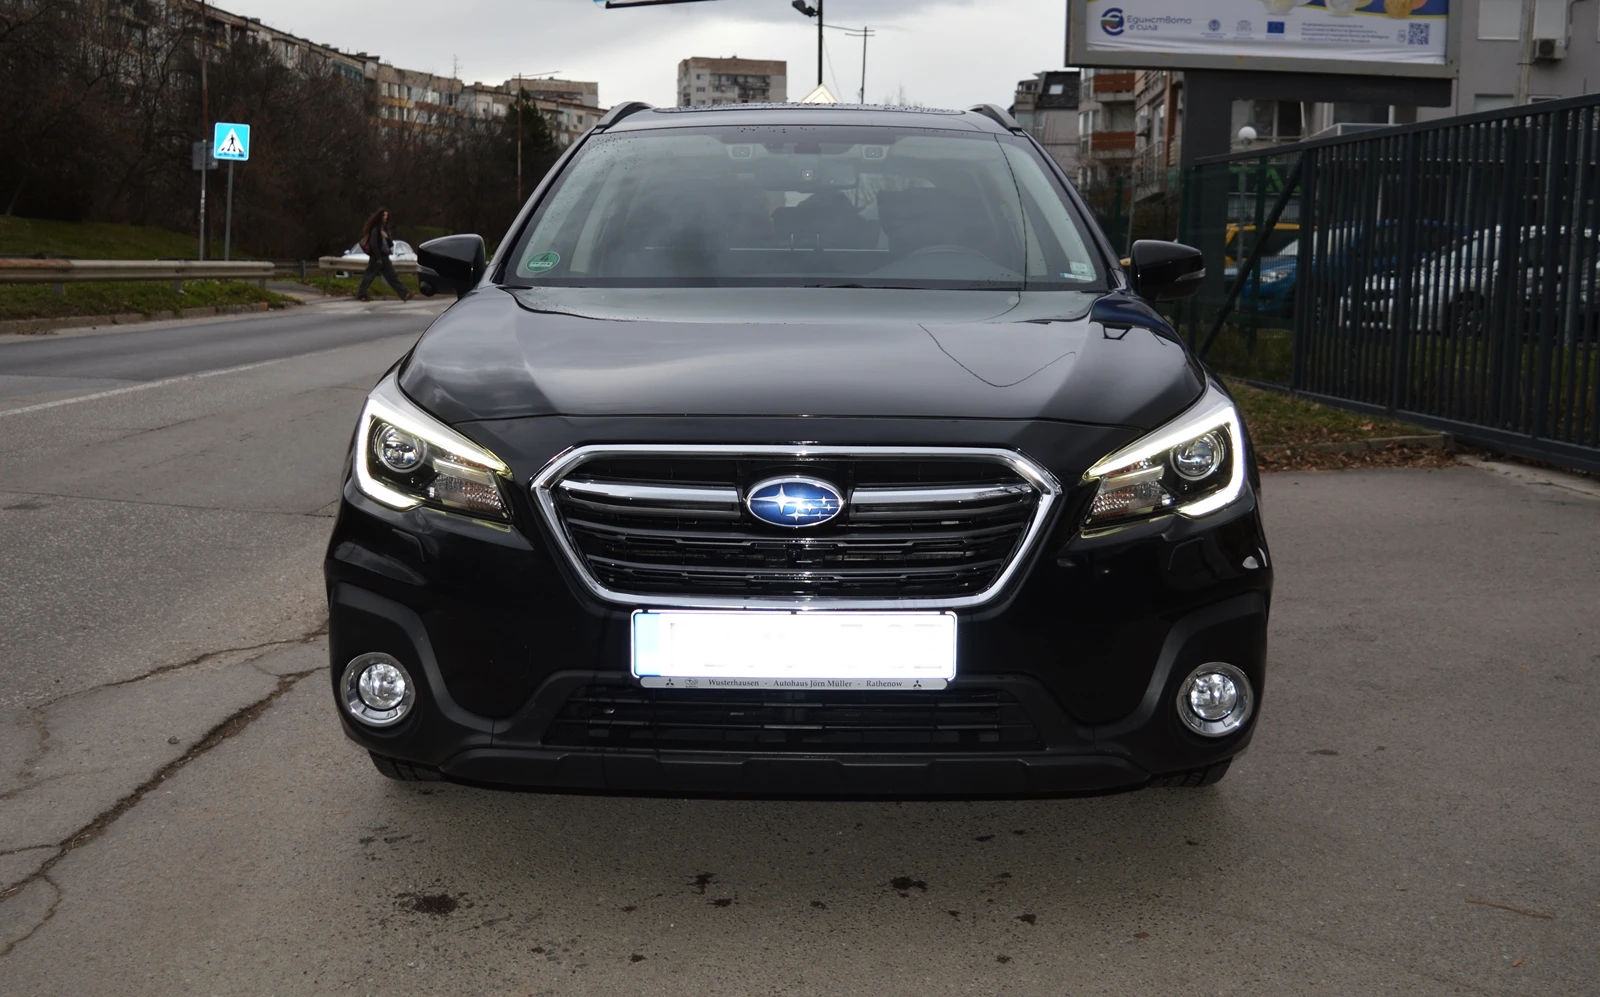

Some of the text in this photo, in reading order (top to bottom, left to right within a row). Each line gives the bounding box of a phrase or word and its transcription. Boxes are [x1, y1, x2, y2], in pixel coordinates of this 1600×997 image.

[1127, 15, 1192, 25] Единството
[708, 679, 759, 687] Wusterhausen
[773, 679, 808, 687] Autohaus
[810, 679, 825, 688] Jörn
[827, 679, 852, 687] Müller
